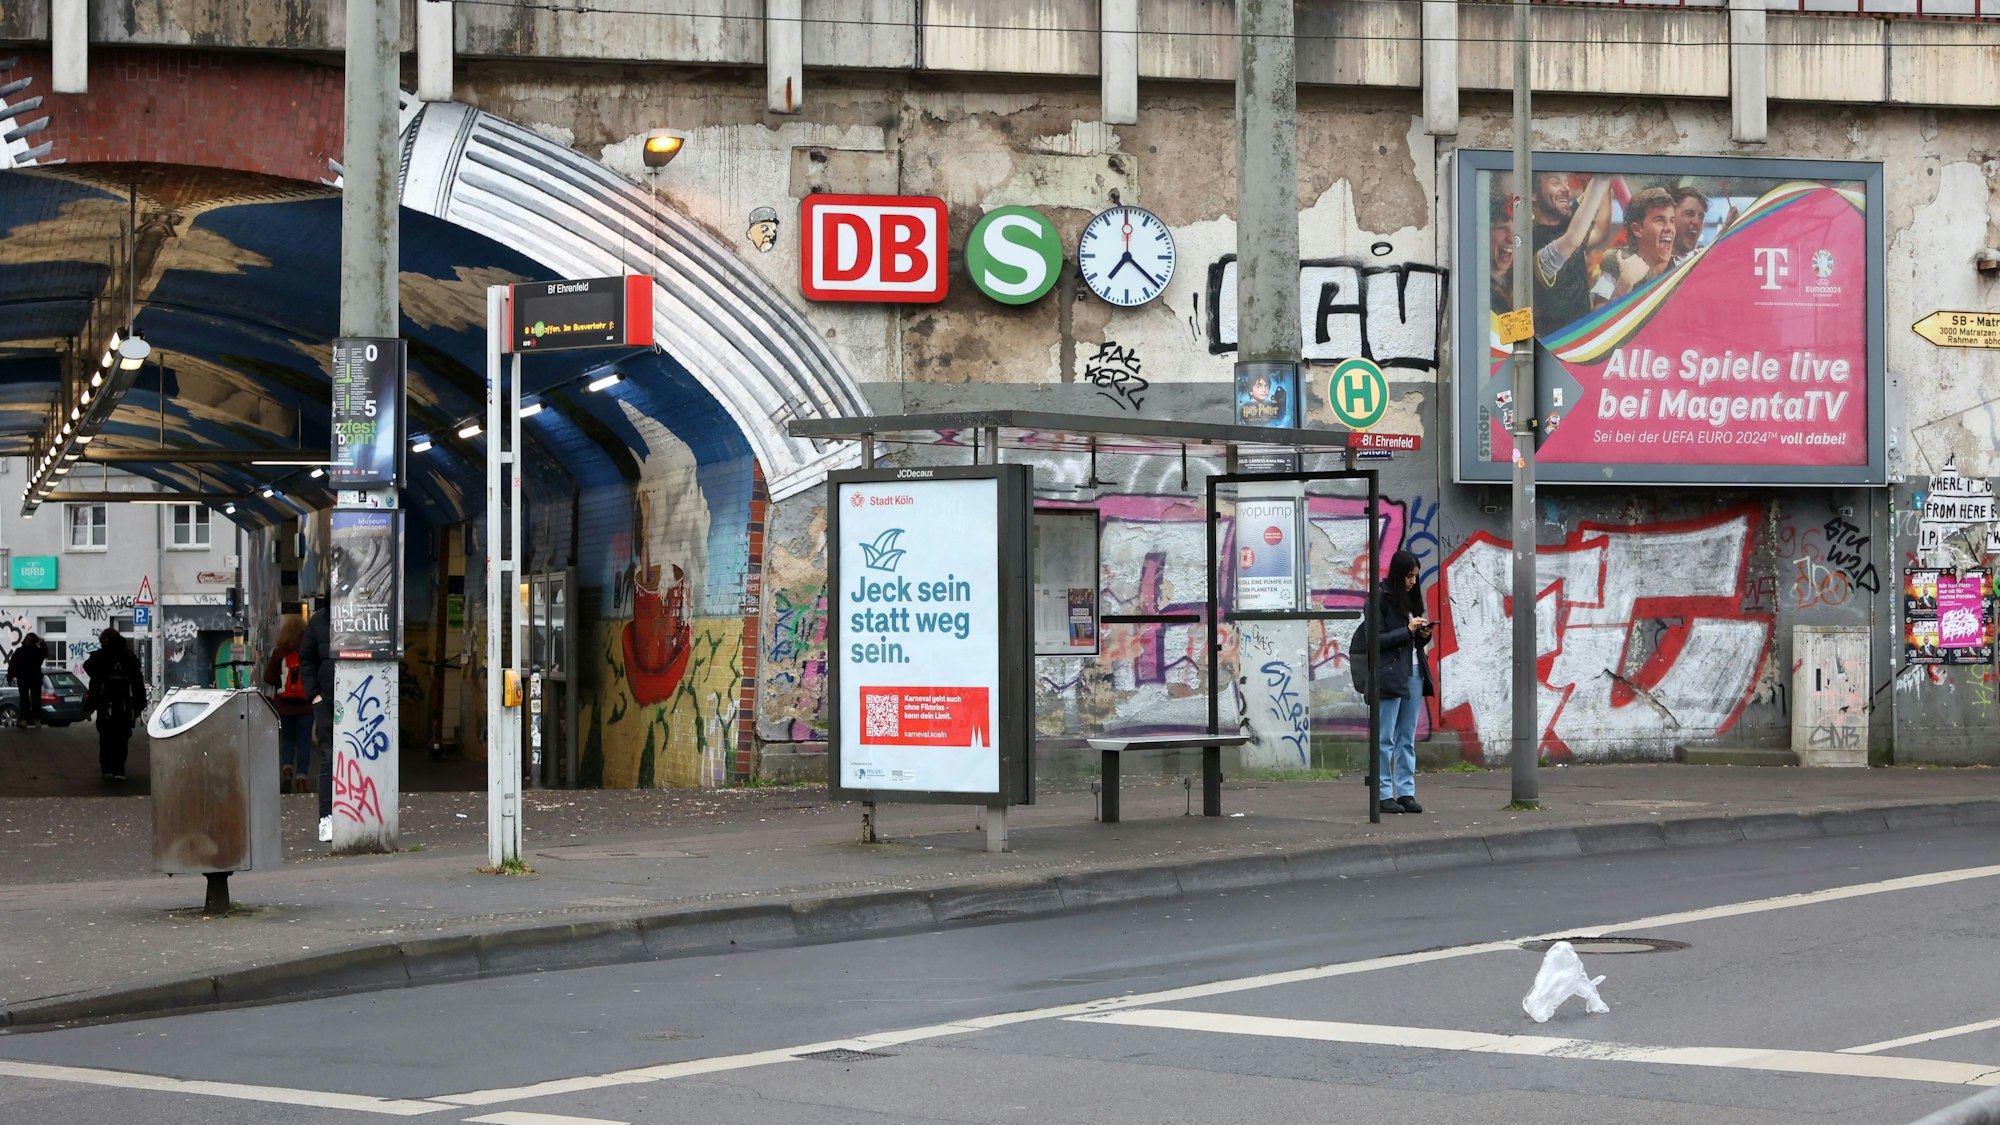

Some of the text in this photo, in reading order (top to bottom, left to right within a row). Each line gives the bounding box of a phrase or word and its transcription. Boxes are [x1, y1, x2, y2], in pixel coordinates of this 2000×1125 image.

[822, 212, 929, 283] DB
[983, 214, 1048, 296] S
[1754, 247, 1788, 290] T
[547, 282, 589, 294] Bf Ehrenfeld
[1952, 315, 1967, 326] SB
[1939, 327, 1957, 335] 3000
[1960, 328, 1997, 337] Matratzen
[1947, 336, 1979, 344] Rahmen
[365, 344, 378, 362] 0
[1602, 348, 1850, 388] Alle Spiele live
[1344, 374, 1373, 413] H
[364, 400, 377, 417] 5
[1597, 388, 1849, 428] bei MagentaTV
[337, 432, 376, 446] bonn
[1362, 435, 1414, 448] Bf. Ehrenfeld
[1593, 429, 1613, 443] Sei
[1615, 430, 1635, 443] bei
[1638, 430, 1659, 443] der
[1662, 431, 1695, 444] UEFA
[1697, 431, 1733, 444] EURO
[1780, 433, 1802, 445] voll
[1805, 432, 1847, 445] dabei!
[897, 469, 934, 479] JCDecaux
[869, 495, 914, 506] Stadt Köln
[1926, 503, 1956, 519] FROM
[1960, 504, 1986, 519] HERE
[850, 574, 971, 603] Jeck sein
[135, 609, 145, 622] P
[850, 607, 970, 640] statt weg
[850, 636, 910, 664] sein.
[931, 696, 946, 704] geht
[935, 712, 952, 720] Limit.
[904, 731, 947, 739] karneval.koeln
